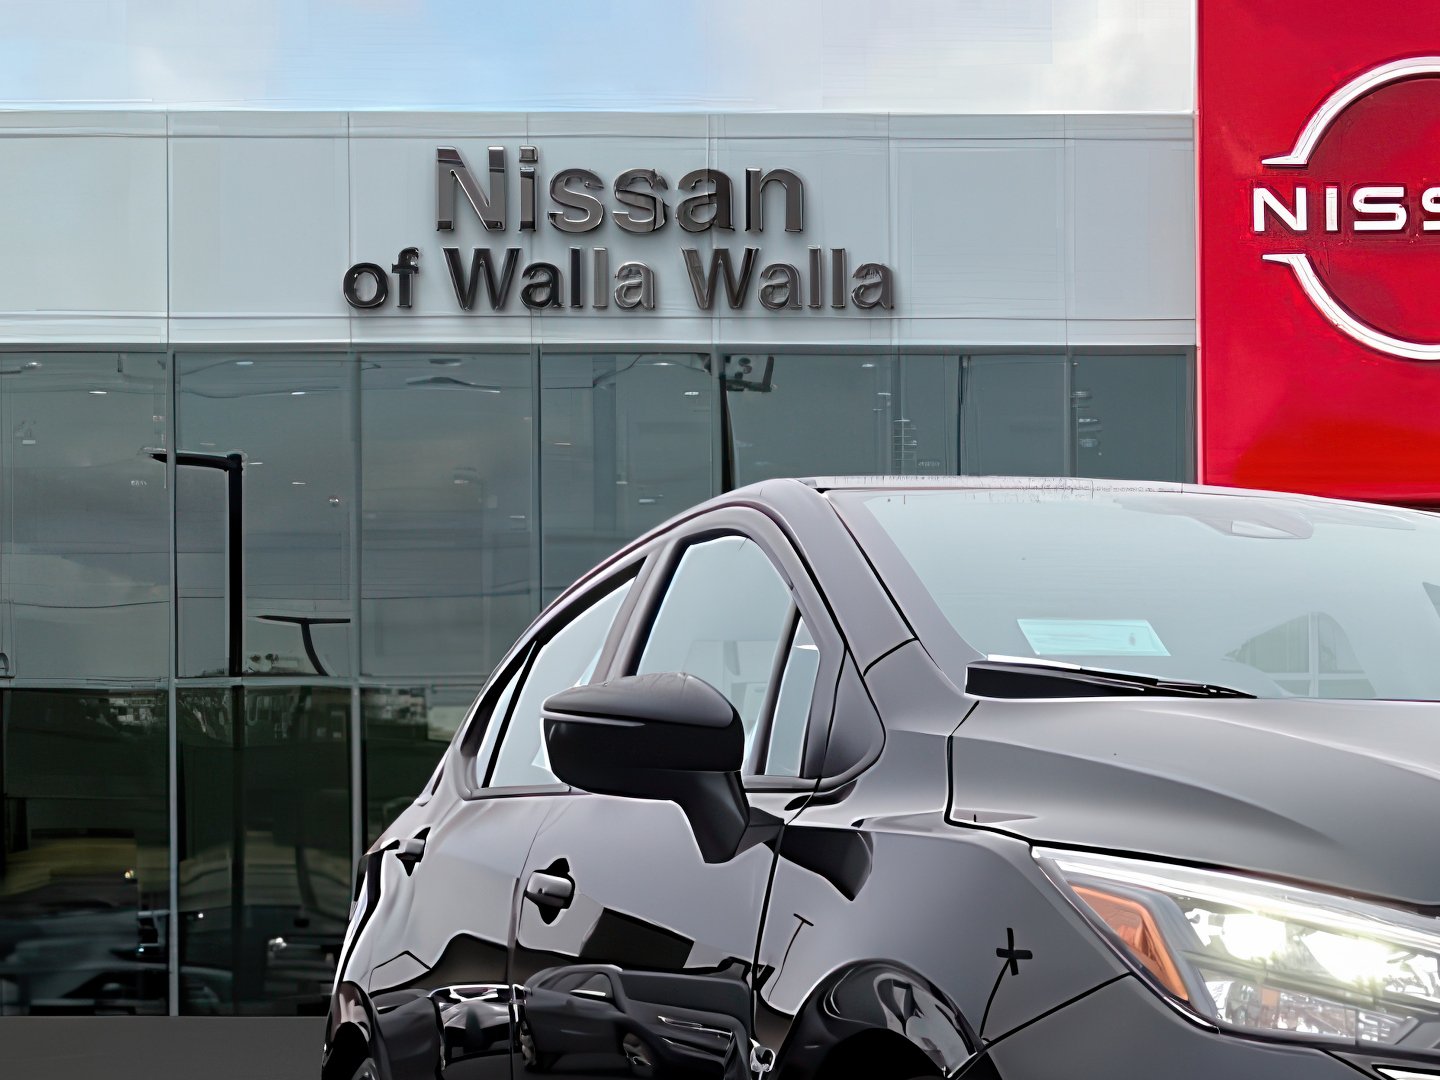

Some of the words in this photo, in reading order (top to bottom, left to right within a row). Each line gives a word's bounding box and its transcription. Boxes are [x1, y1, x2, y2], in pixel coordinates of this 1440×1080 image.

[435, 144, 807, 233] Nissan
[342, 246, 421, 309] of
[442, 246, 655, 310] Walla
[680, 246, 894, 310] Walla
